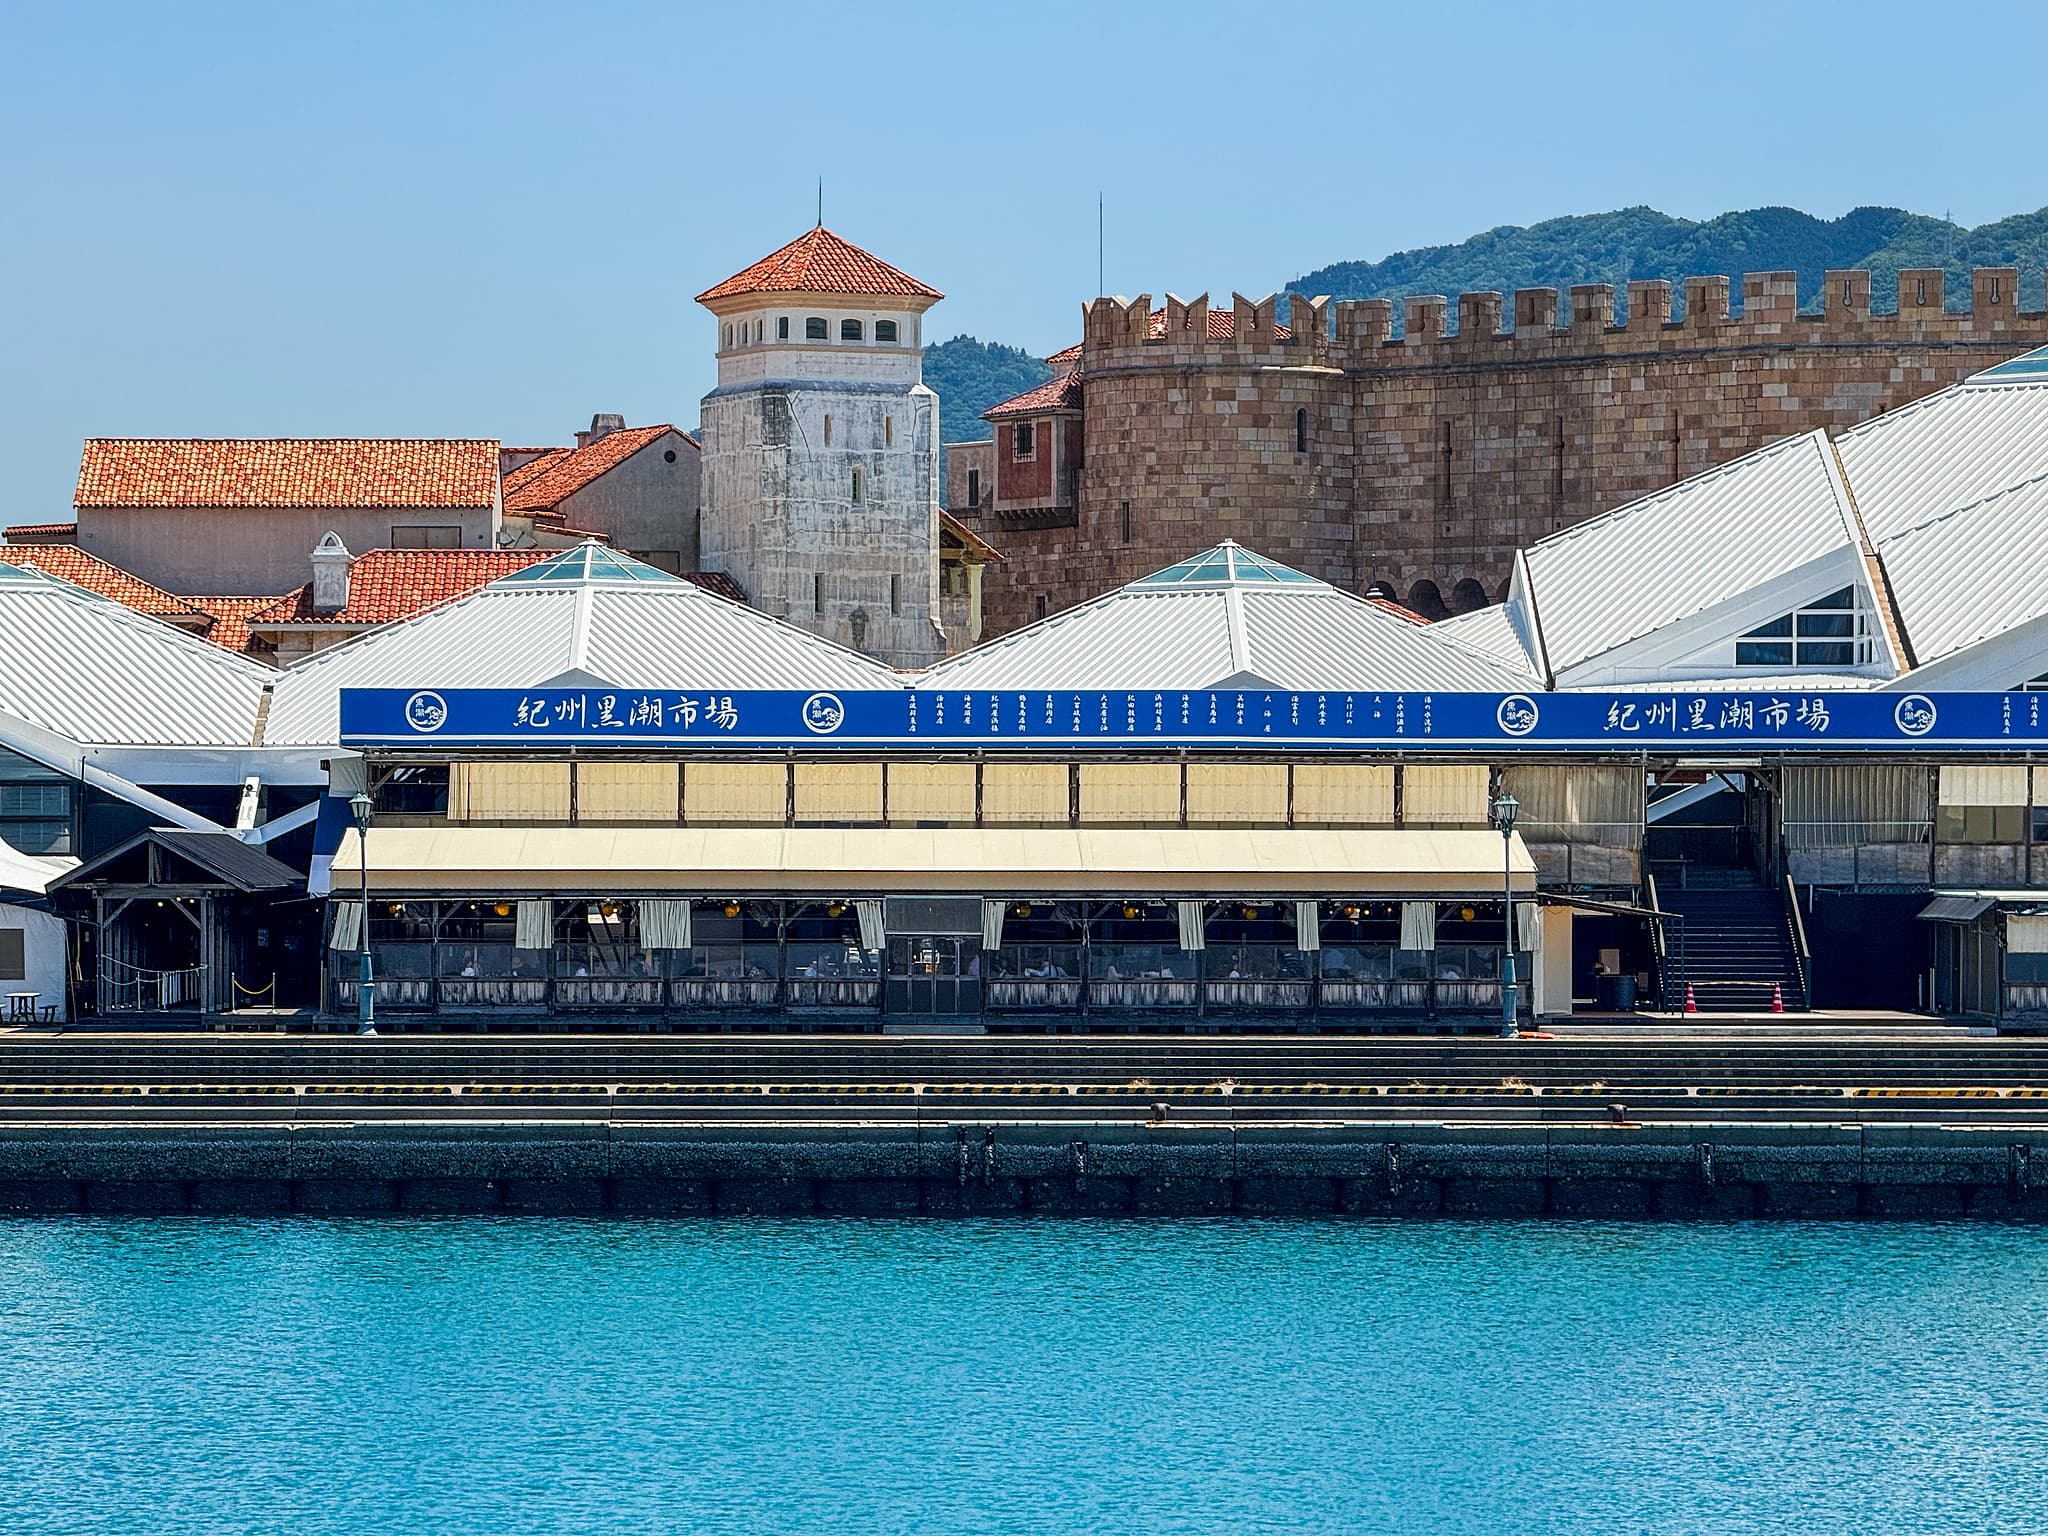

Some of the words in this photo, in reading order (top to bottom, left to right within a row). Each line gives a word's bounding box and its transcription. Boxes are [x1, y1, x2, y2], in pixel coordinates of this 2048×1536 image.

[513, 695, 737, 729] 紀州黒潮市場
[1604, 698, 1829, 731] 紀州黒潮市場
